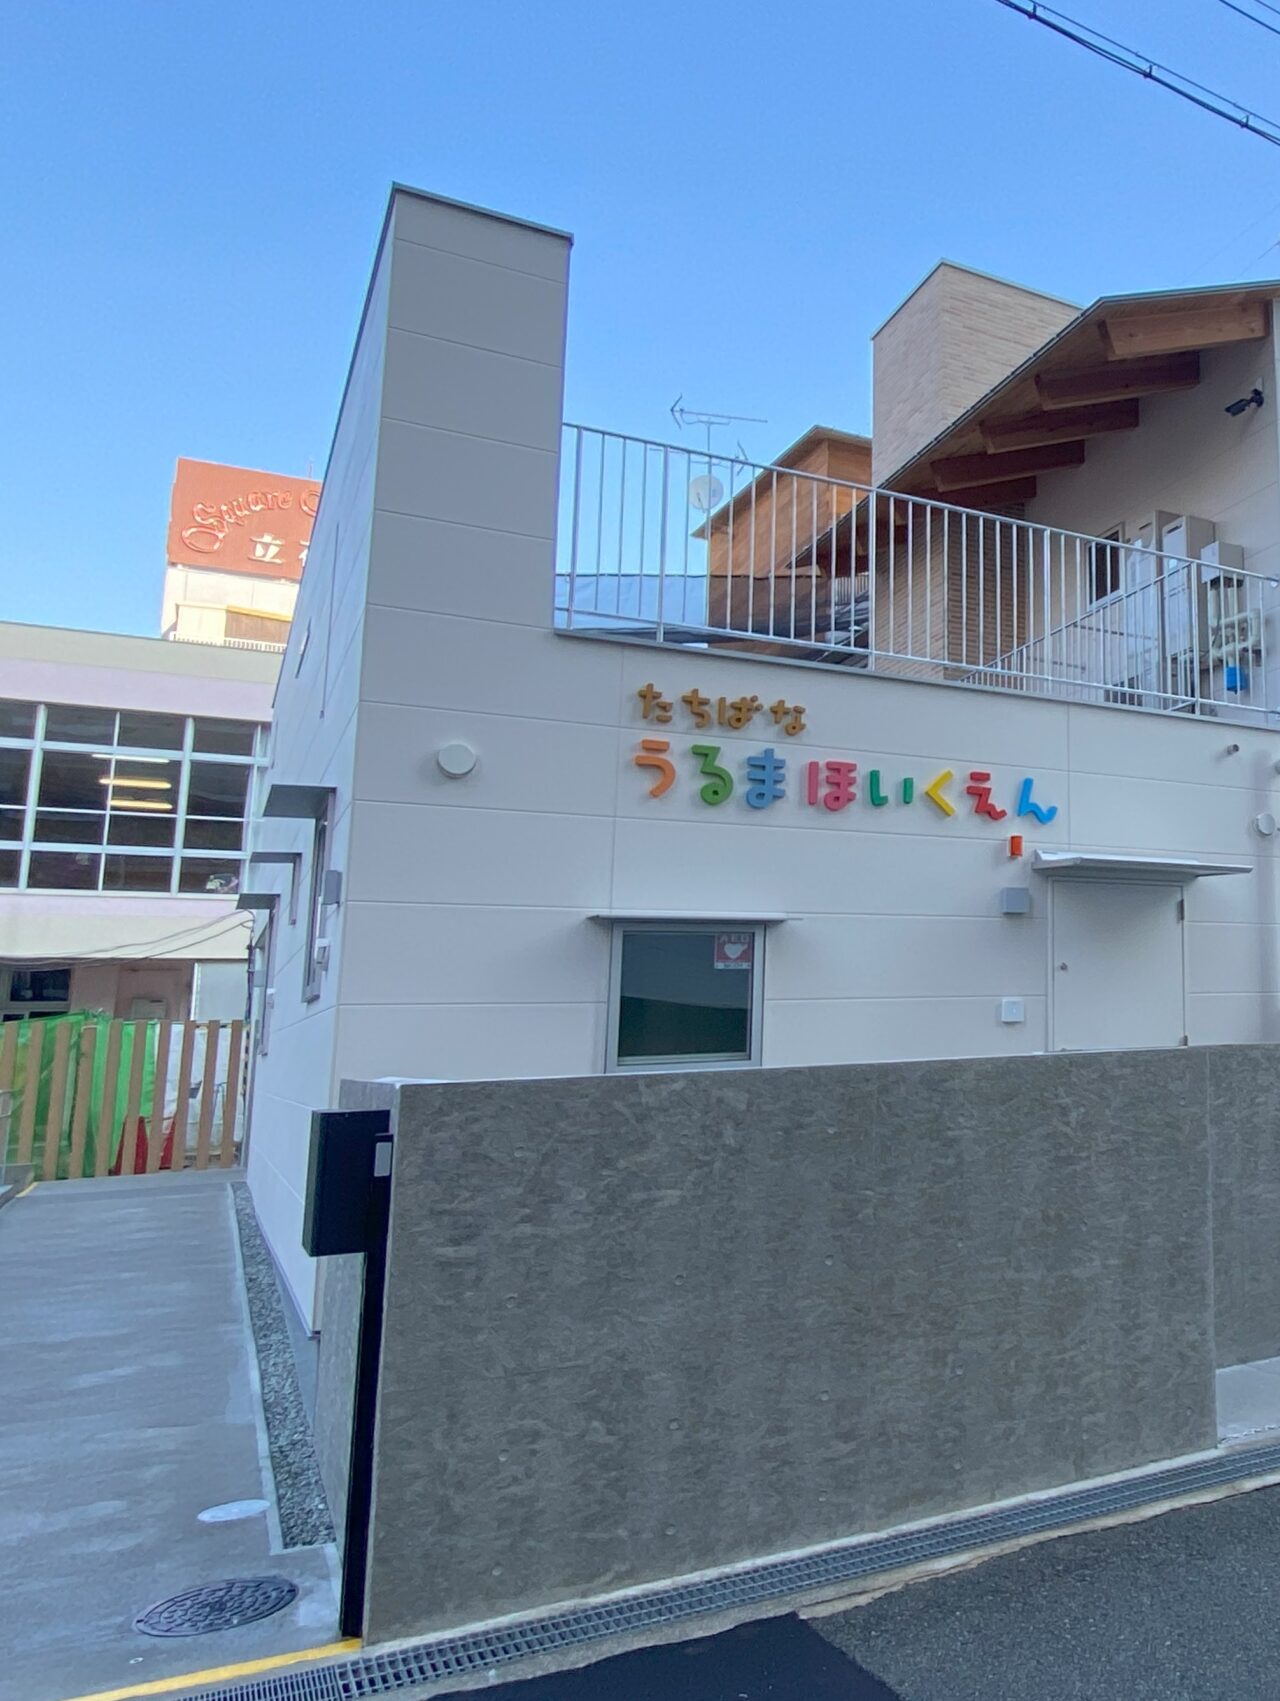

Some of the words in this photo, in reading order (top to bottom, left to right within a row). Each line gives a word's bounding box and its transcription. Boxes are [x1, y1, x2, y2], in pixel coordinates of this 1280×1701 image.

[182, 491, 293, 553] Square
[638, 683, 806, 735] たちばな
[635, 739, 1058, 824] うるまほいくえん
